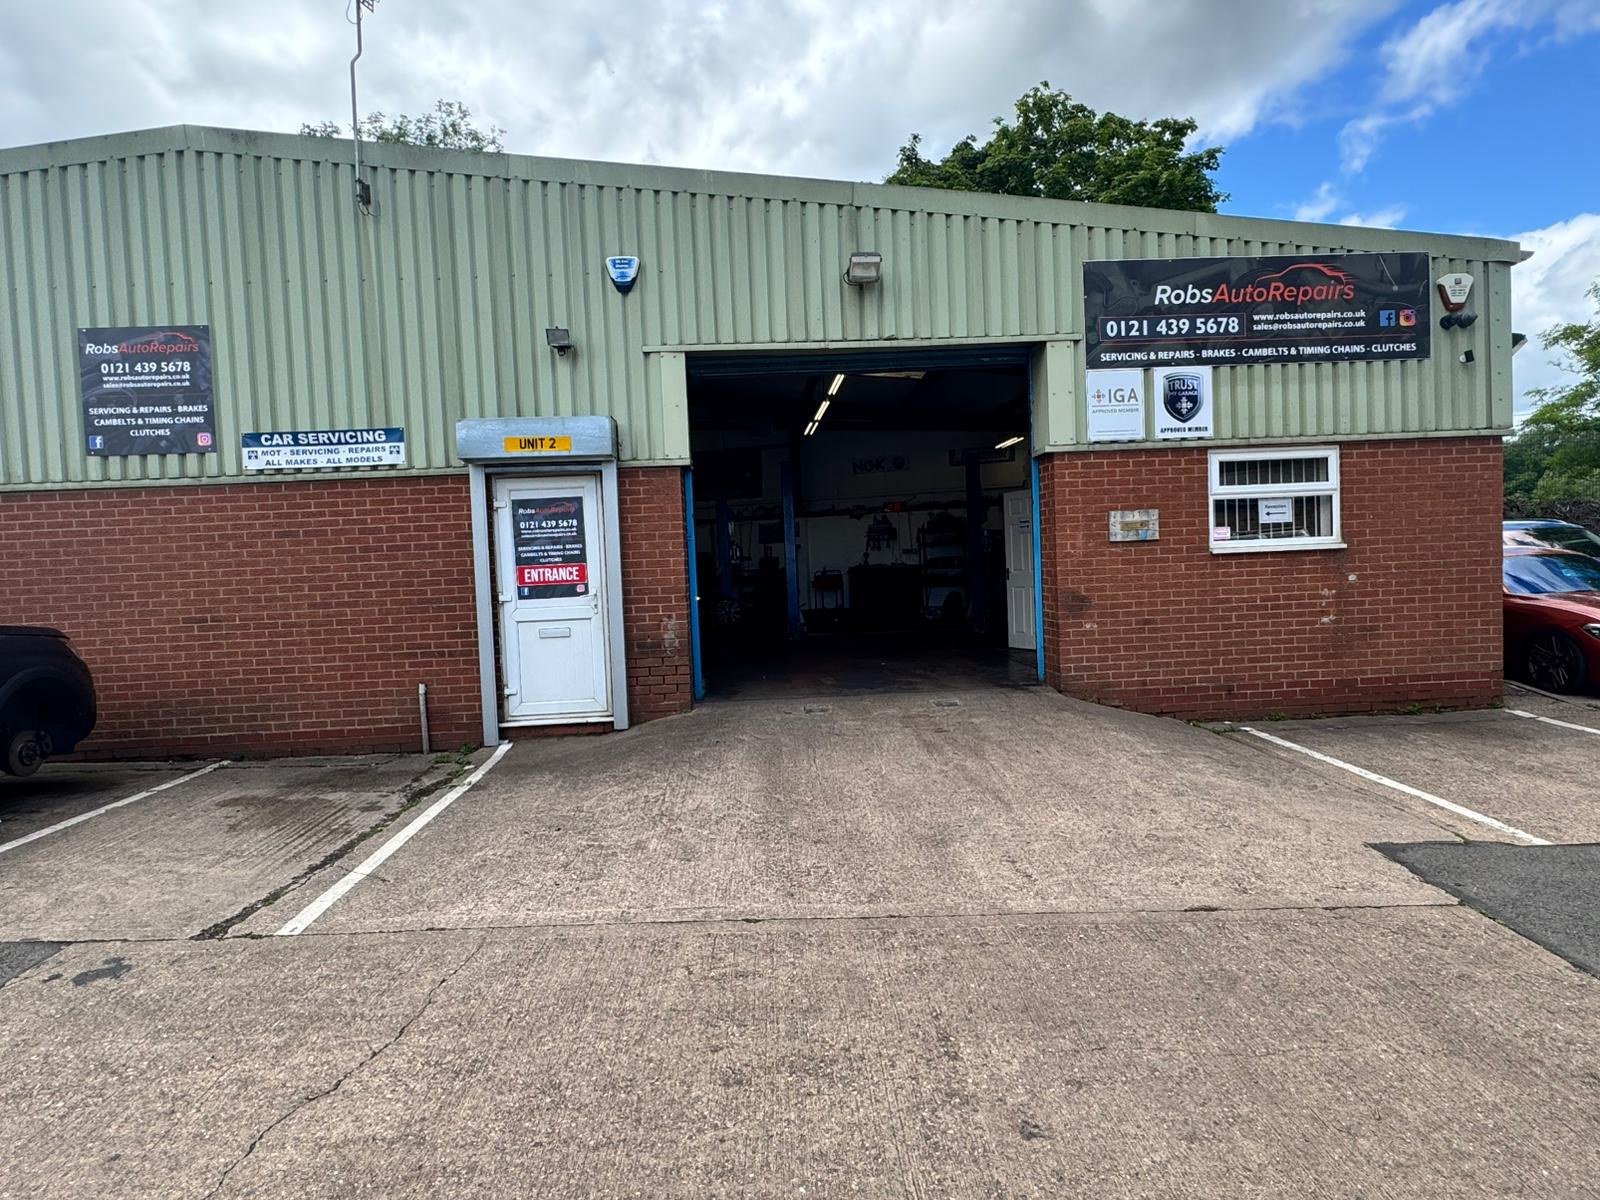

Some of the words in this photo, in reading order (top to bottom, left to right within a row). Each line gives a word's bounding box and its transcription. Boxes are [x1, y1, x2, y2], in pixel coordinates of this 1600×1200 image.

[1154, 281, 1355, 305] RobsAutoRepairs
[1253, 309, 1366, 321] www.robsautorepairs.co.uk
[1106, 320, 1148, 337] 0121
[1156, 318, 1189, 335] 439
[1196, 317, 1239, 334] 5678
[1253, 320, 1366, 331] sales@robsautorepairs.co.uk
[85, 341, 199, 354] RobsAutoRepairs
[1101, 352, 1147, 361] SERVICING
[1150, 351, 1156, 360] &
[1158, 350, 1194, 359] REPAIRS
[1202, 349, 1235, 357] BRAKES
[1242, 347, 1288, 357] CAMBELTS
[1290, 347, 1297, 355] &
[1298, 346, 1330, 355] TIMING
[1333, 345, 1365, 354] CHAINS
[1372, 343, 1416, 352] CLUTCHES
[101, 363, 129, 373] 0121
[134, 362, 157, 373] 439
[160, 361, 191, 372] 5678
[1169, 379, 1199, 390] TRUST
[1108, 388, 1139, 404] IGA
[88, 407, 131, 415] SERVICING
[132, 406, 138, 414] &
[94, 418, 136, 426] CAMBELTS
[137, 417, 143, 425] &
[144, 416, 173, 425] TIMING
[174, 416, 204, 424] CHAINS
[130, 428, 171, 437] CLUTCHES
[261, 434, 294, 446] CAR
[298, 430, 386, 445] SERVICING
[519, 437, 545, 449] UNIT
[549, 438, 556, 449] 2
[289, 448, 341, 456] SERVICING
[348, 446, 386, 454] REPAIRS
[265, 459, 282, 467] ALL
[285, 458, 318, 466] MAKES
[326, 457, 342, 465] ALL
[345, 456, 383, 464] MODELS
[520, 521, 538, 529] 0121
[541, 520, 556, 528] 439
[559, 519, 577, 527] 5678
[524, 567, 580, 582] ENTRANCE
